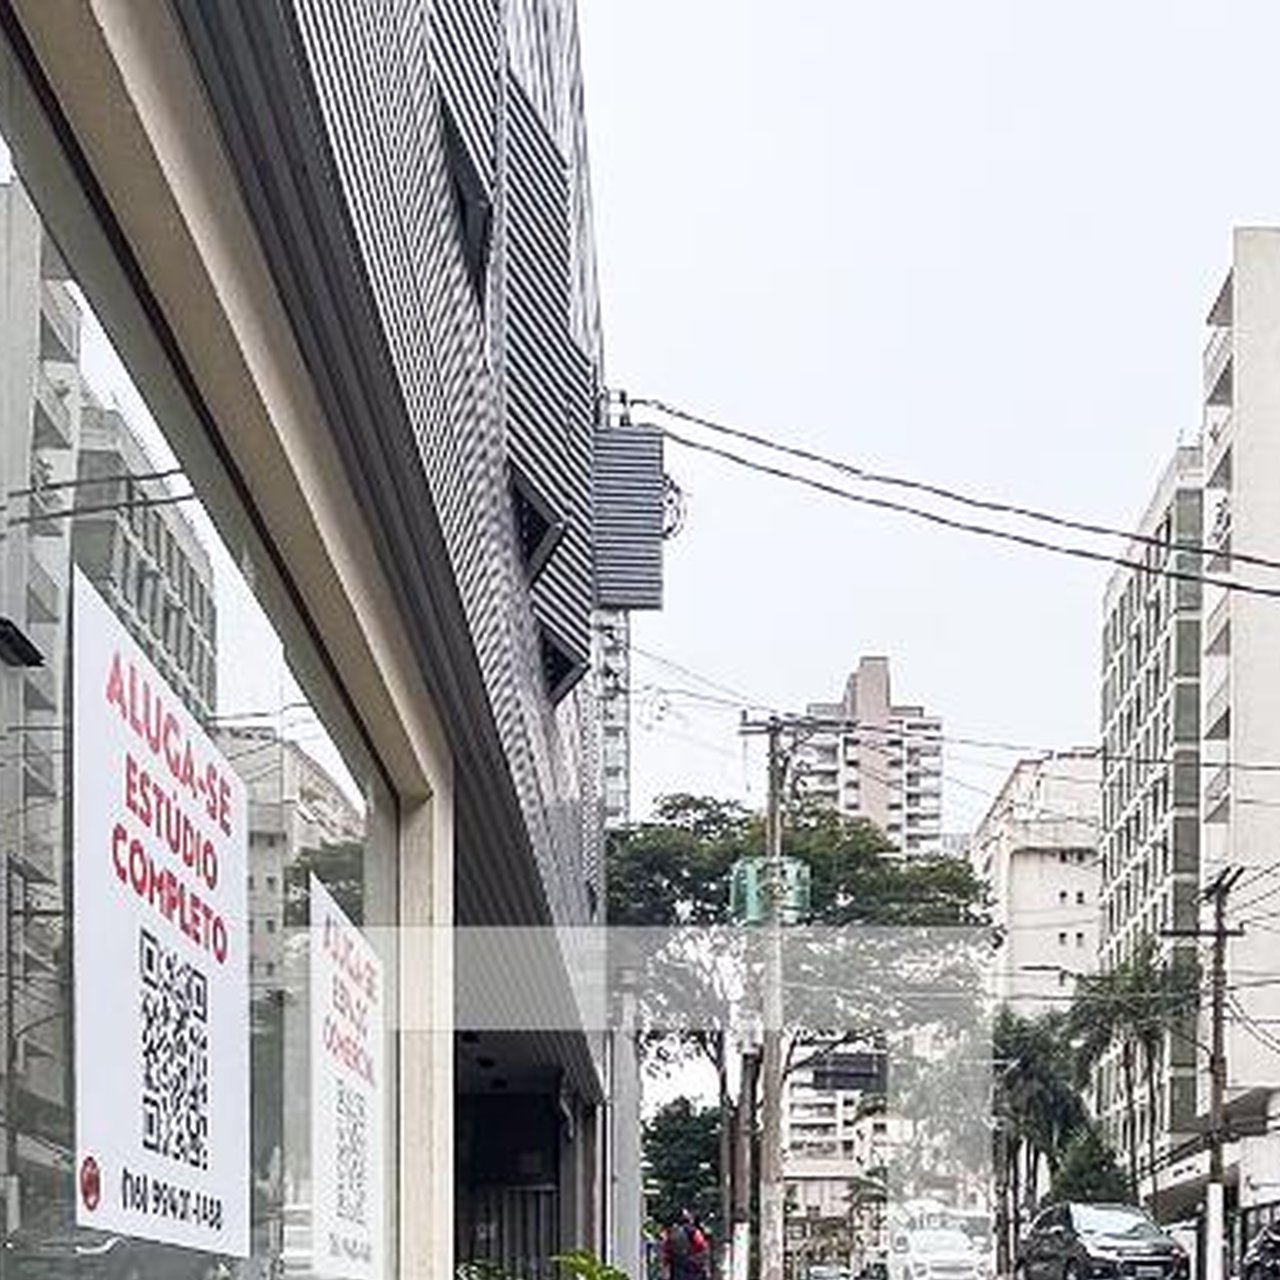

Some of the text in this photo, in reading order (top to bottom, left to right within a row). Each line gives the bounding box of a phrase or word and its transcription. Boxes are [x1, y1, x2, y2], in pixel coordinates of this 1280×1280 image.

[106, 650, 232, 839] ALUGA-SE
[126, 752, 218, 891] ESTÚDIO
[111, 822, 228, 966] COMPLETO
